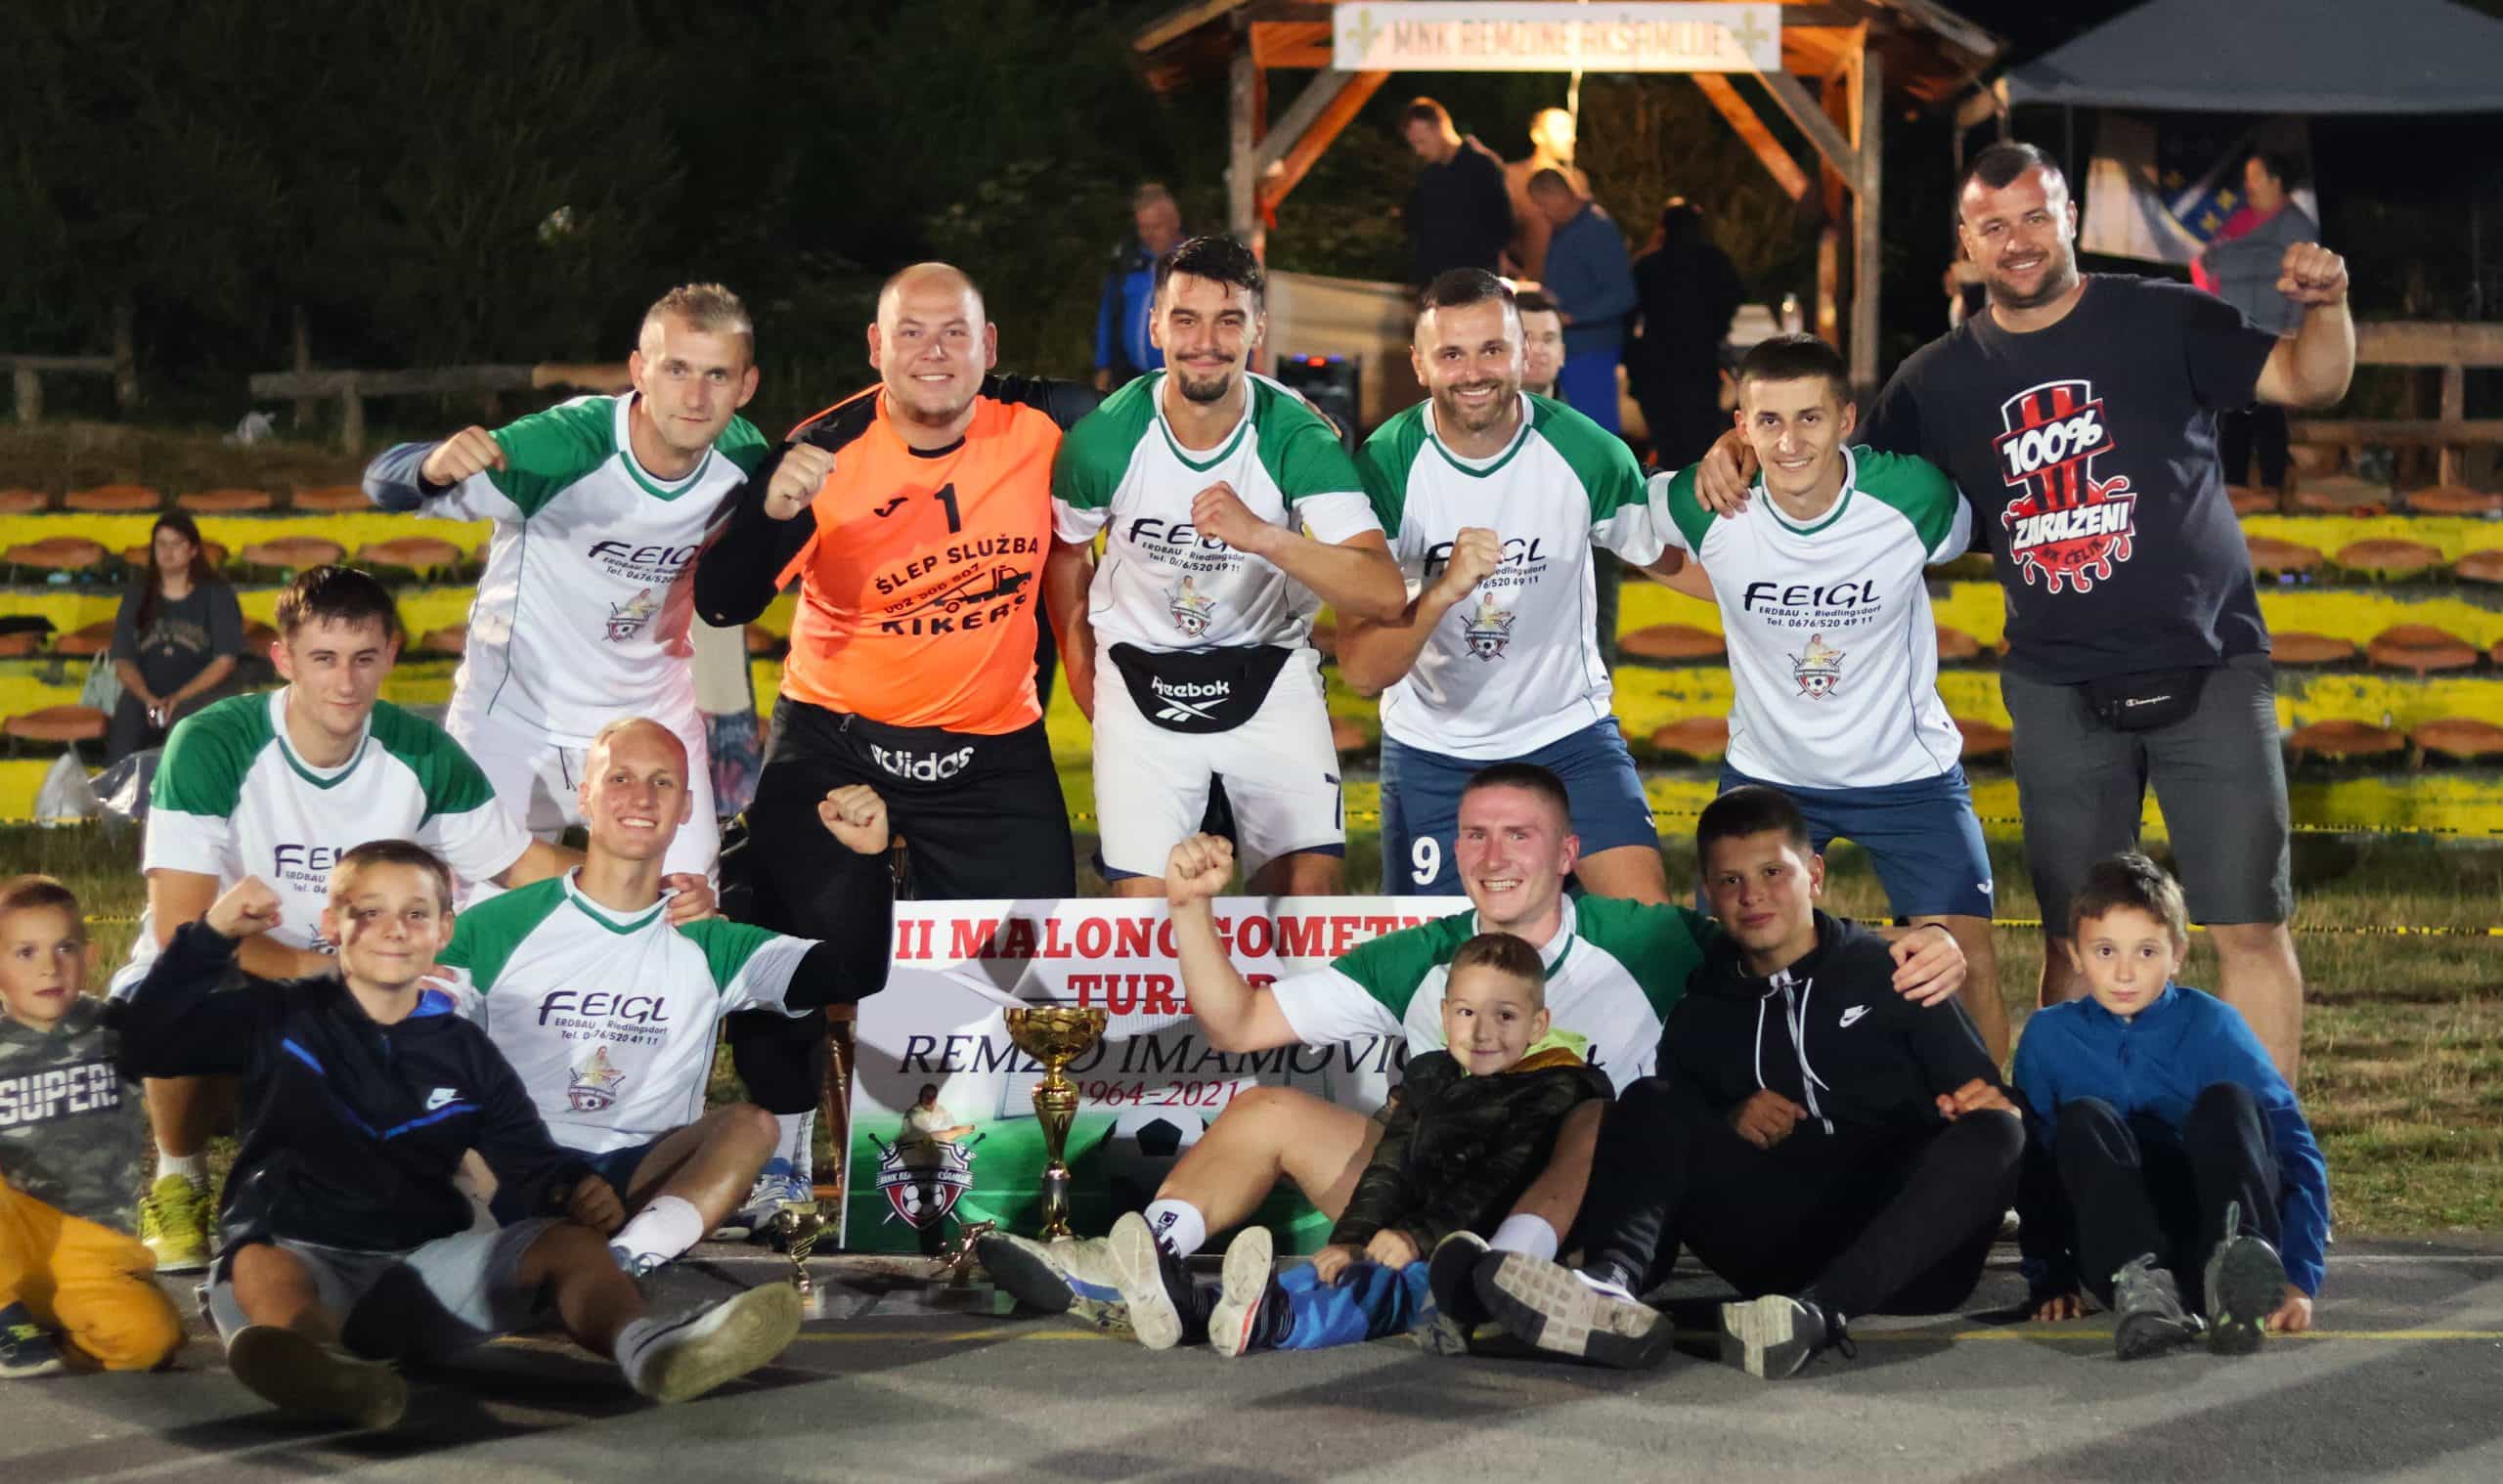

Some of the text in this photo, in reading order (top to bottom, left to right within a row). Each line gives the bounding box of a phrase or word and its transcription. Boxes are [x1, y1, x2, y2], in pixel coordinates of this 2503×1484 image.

[2003, 410, 2103, 477] 100%
[934, 483, 961, 534] 1
[2013, 502, 2129, 550] ZARAŽENI
[875, 534, 1038, 595] ŠLEP SLUŽBA
[1424, 538, 1546, 577] FGL
[1742, 580, 1880, 611] FEIGL
[1759, 606, 1800, 618] ERDBAU
[1767, 618, 1784, 627] Tel.
[1843, 618, 1857, 627] 49
[1862, 616, 1872, 625] 11
[1152, 676, 1230, 699] Reebok
[870, 743, 975, 782] adidas
[1324, 772, 1340, 830] 7
[1411, 836, 1441, 885] 9
[895, 919, 936, 959] II
[538, 990, 669, 1026] FEIGL
[554, 1018, 596, 1028] ERDBAU
[0, 1064, 118, 1125] SUPER!
